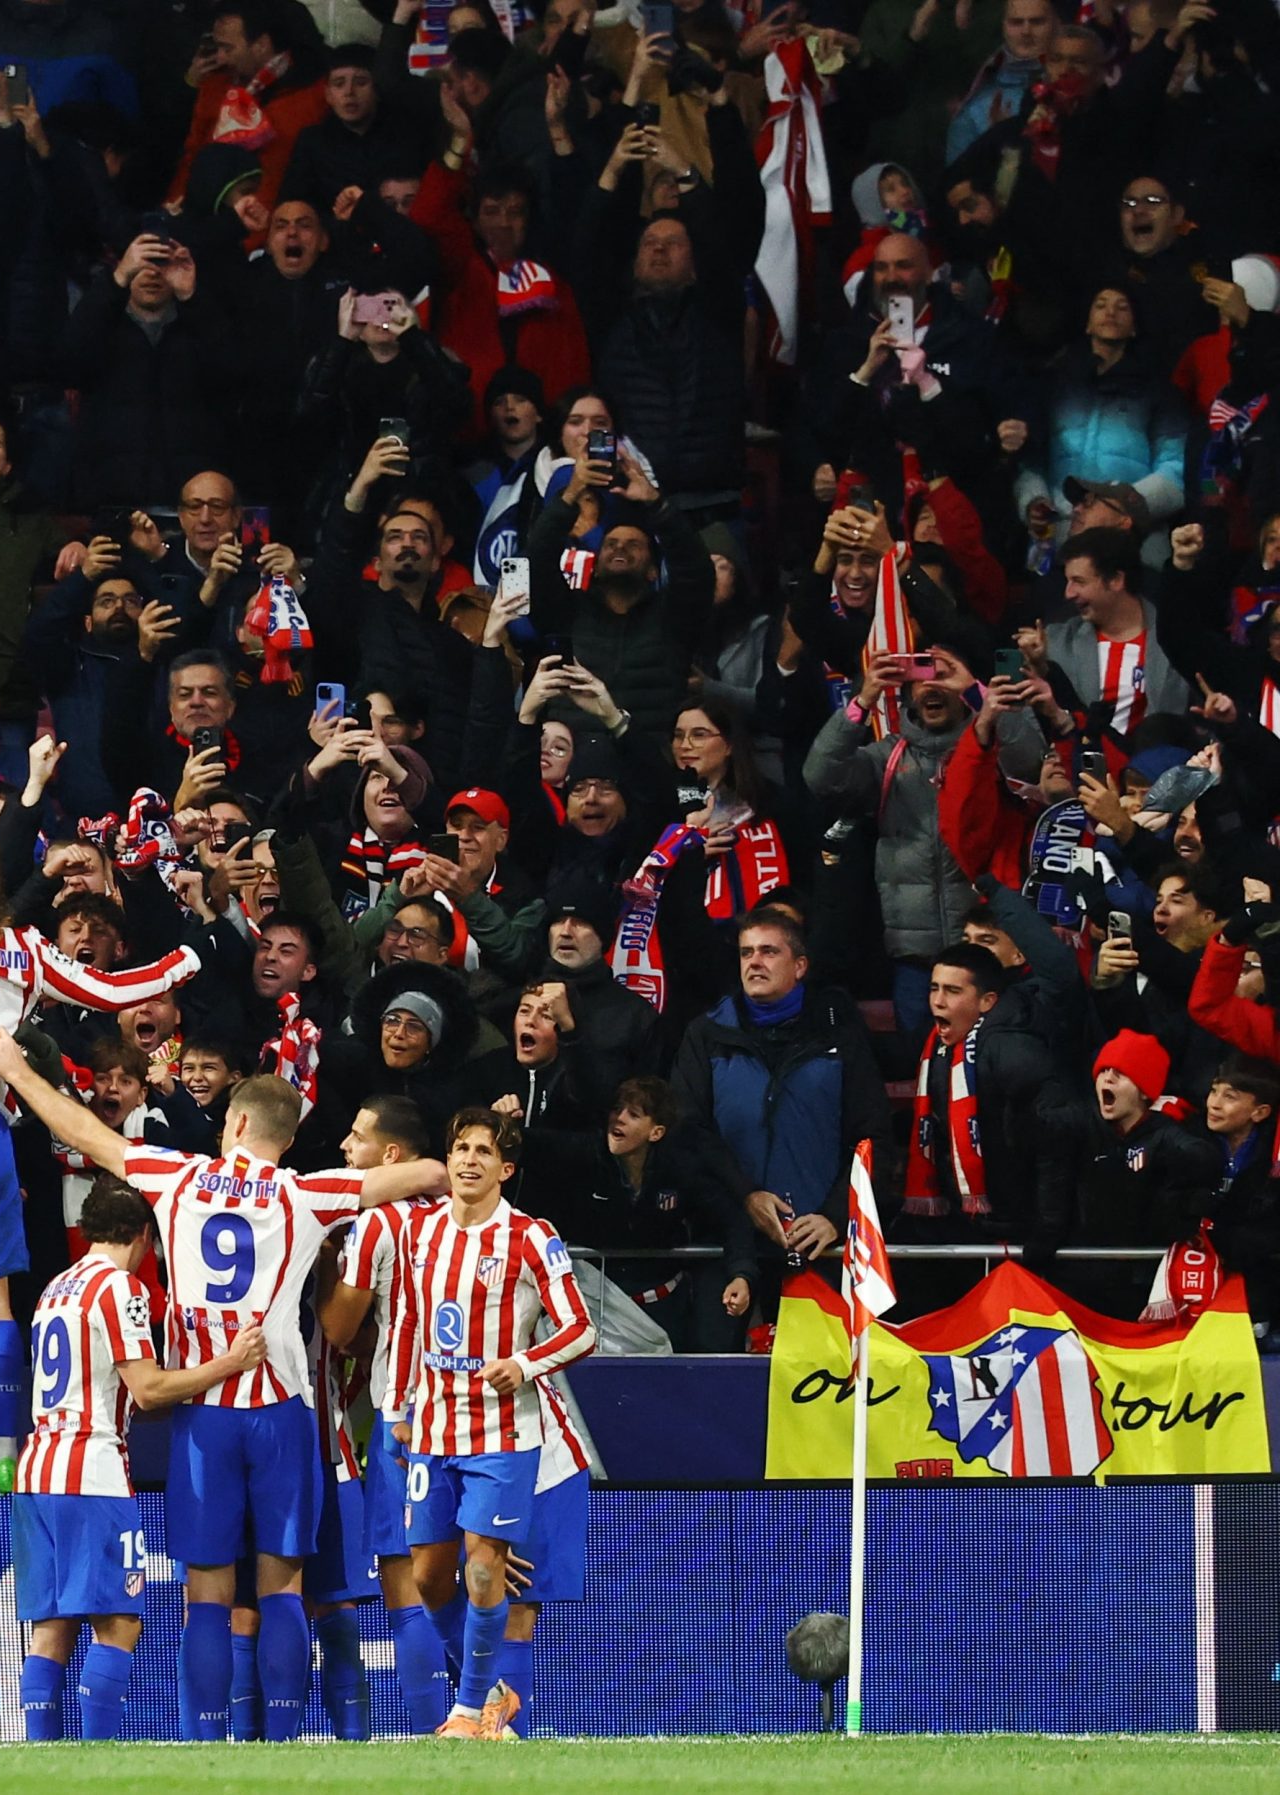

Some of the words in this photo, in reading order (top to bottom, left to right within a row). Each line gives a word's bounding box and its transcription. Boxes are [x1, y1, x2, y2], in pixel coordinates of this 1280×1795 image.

[195, 1173, 277, 1199] SØRLOTH
[200, 1212, 256, 1304] 9
[460, 1354, 483, 1371] AIR
[406, 1461, 430, 1503] 0
[119, 1529, 145, 1570] 19
